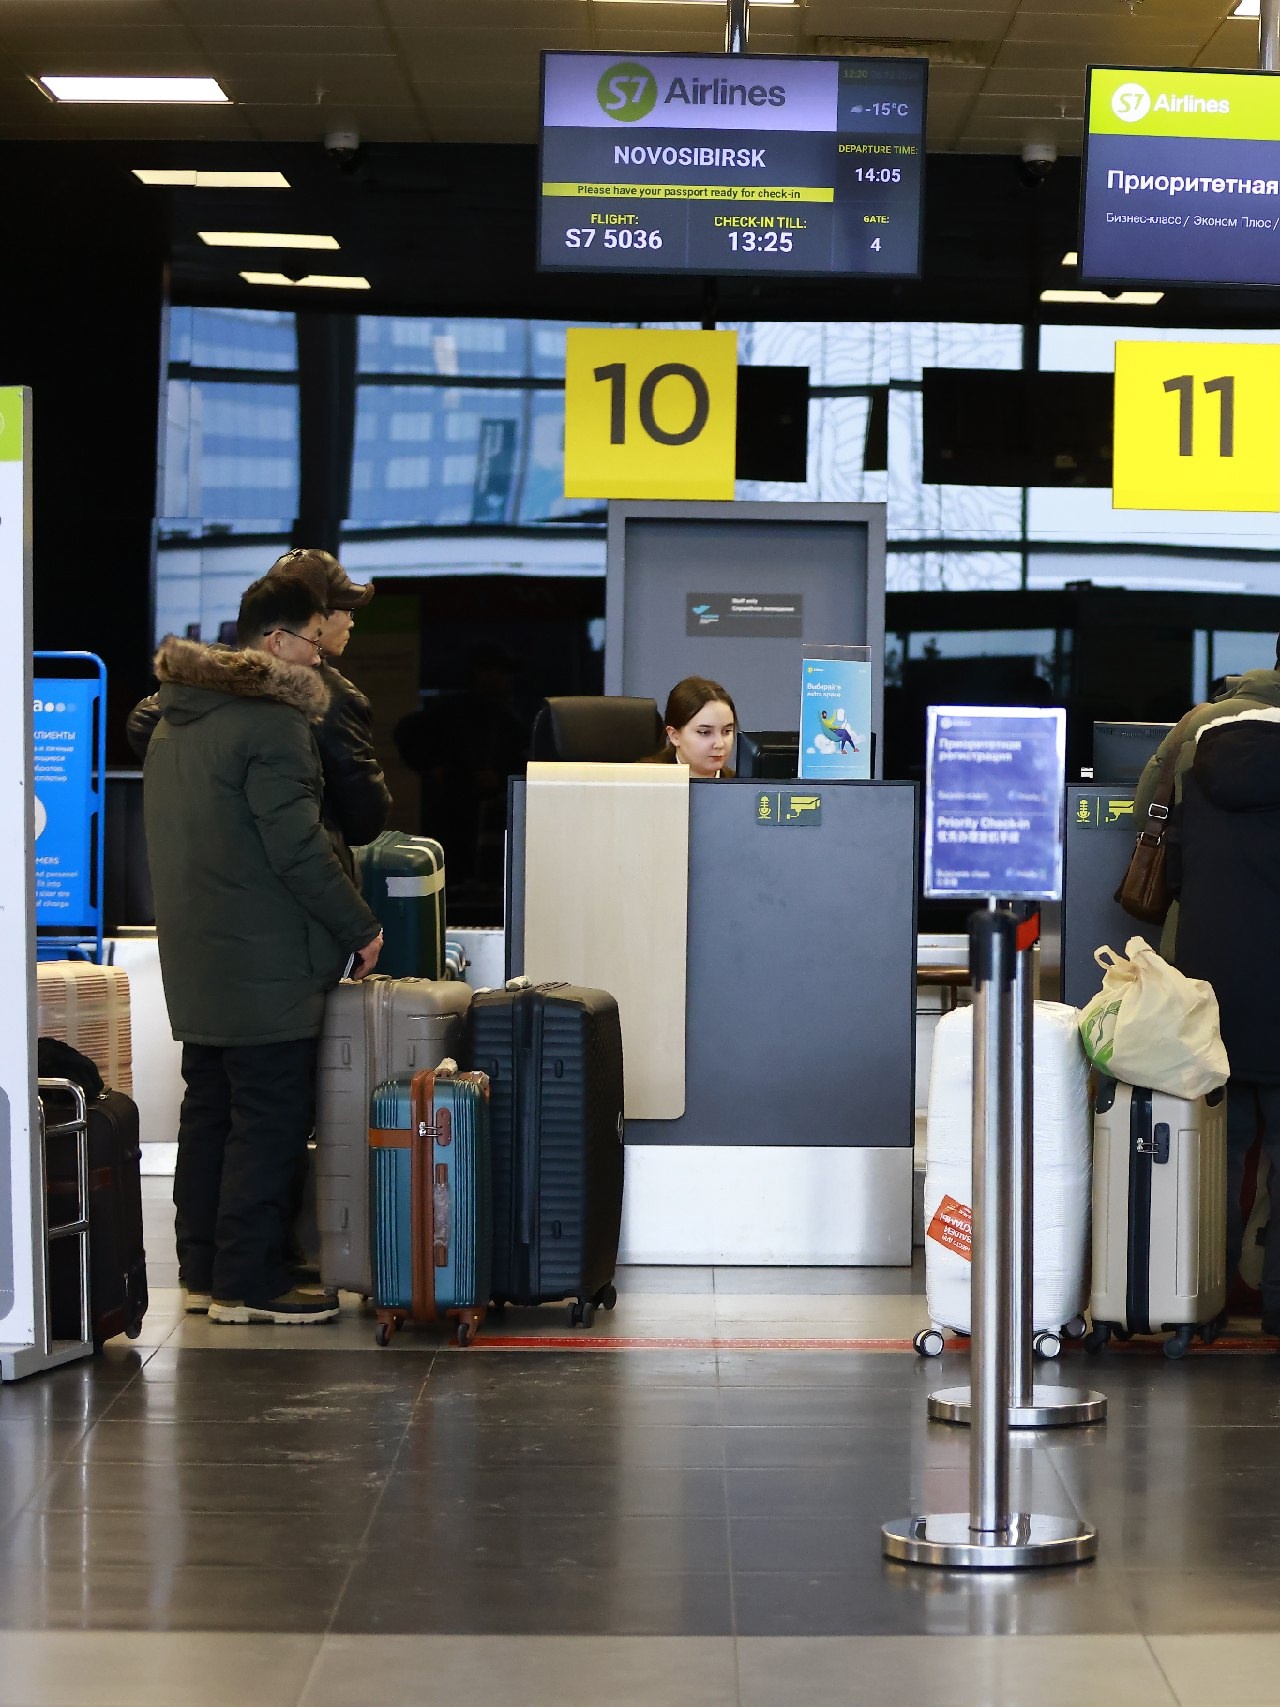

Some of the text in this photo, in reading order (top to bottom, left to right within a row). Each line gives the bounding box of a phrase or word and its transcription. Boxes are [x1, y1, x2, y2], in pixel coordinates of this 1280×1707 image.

[663, 76, 786, 107] Airlines
[1153, 94, 1230, 114] Airlines
[613, 145, 767, 169] NOVOSIBIRSK
[838, 144, 918, 155] DEPARTURE TIME:
[855, 167, 902, 183] 14:05
[1107, 169, 1279, 196] Приоритетная
[577, 185, 801, 200] Please have your passport ready for check-in
[590, 213, 639, 226] FLIGHT:
[714, 216, 807, 230] CHECK-IN TILL:
[863, 215, 890, 224] GATE:
[565, 228, 663, 250] S7 5036
[728, 231, 794, 253] 13:25
[870, 238, 881, 252] 4
[593, 361, 710, 447] 10
[1162, 374, 1235, 458] 11
